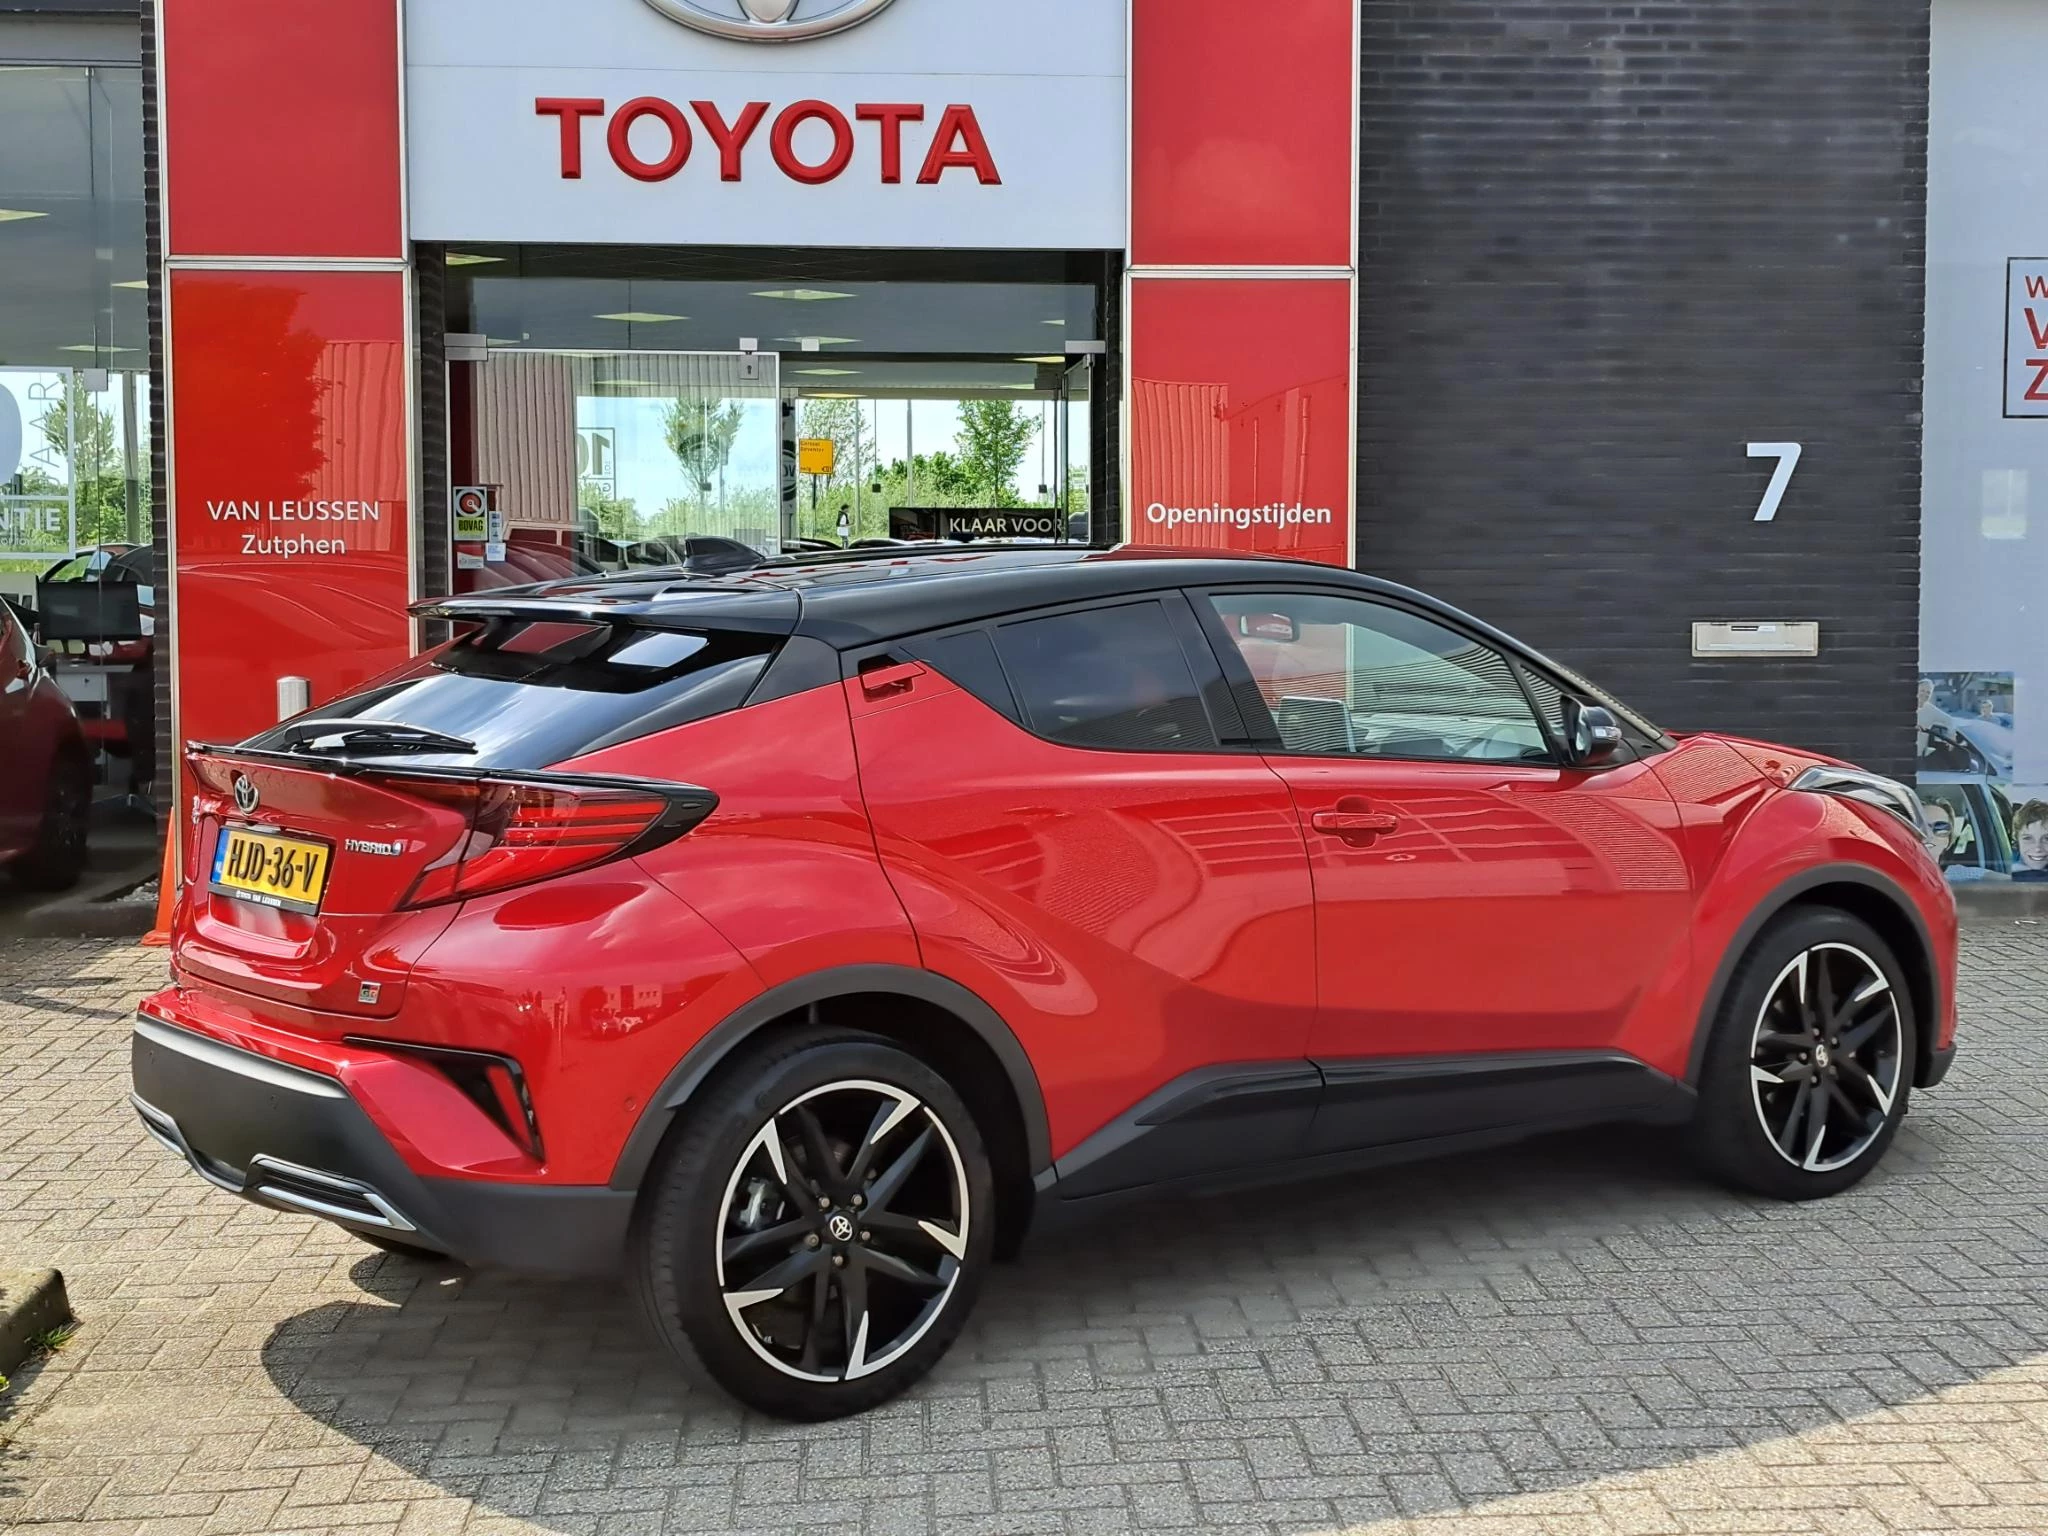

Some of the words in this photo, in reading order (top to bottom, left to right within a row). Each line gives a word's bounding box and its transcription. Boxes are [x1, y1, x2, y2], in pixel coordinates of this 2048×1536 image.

[535, 96, 1002, 185] TOYOTA
[1747, 442, 1802, 521] 7
[207, 501, 260, 521] VAN
[268, 501, 380, 521] LEUSSEN
[1146, 503, 1332, 529] Openingstijden
[458, 519, 484, 531] BOVAG
[949, 518, 1008, 532] KLAAR
[1011, 518, 1064, 532] VOOR
[241, 534, 347, 558] Zutphen
[345, 838, 392, 855] HYBRID
[227, 838, 319, 892] HJD-36-V
